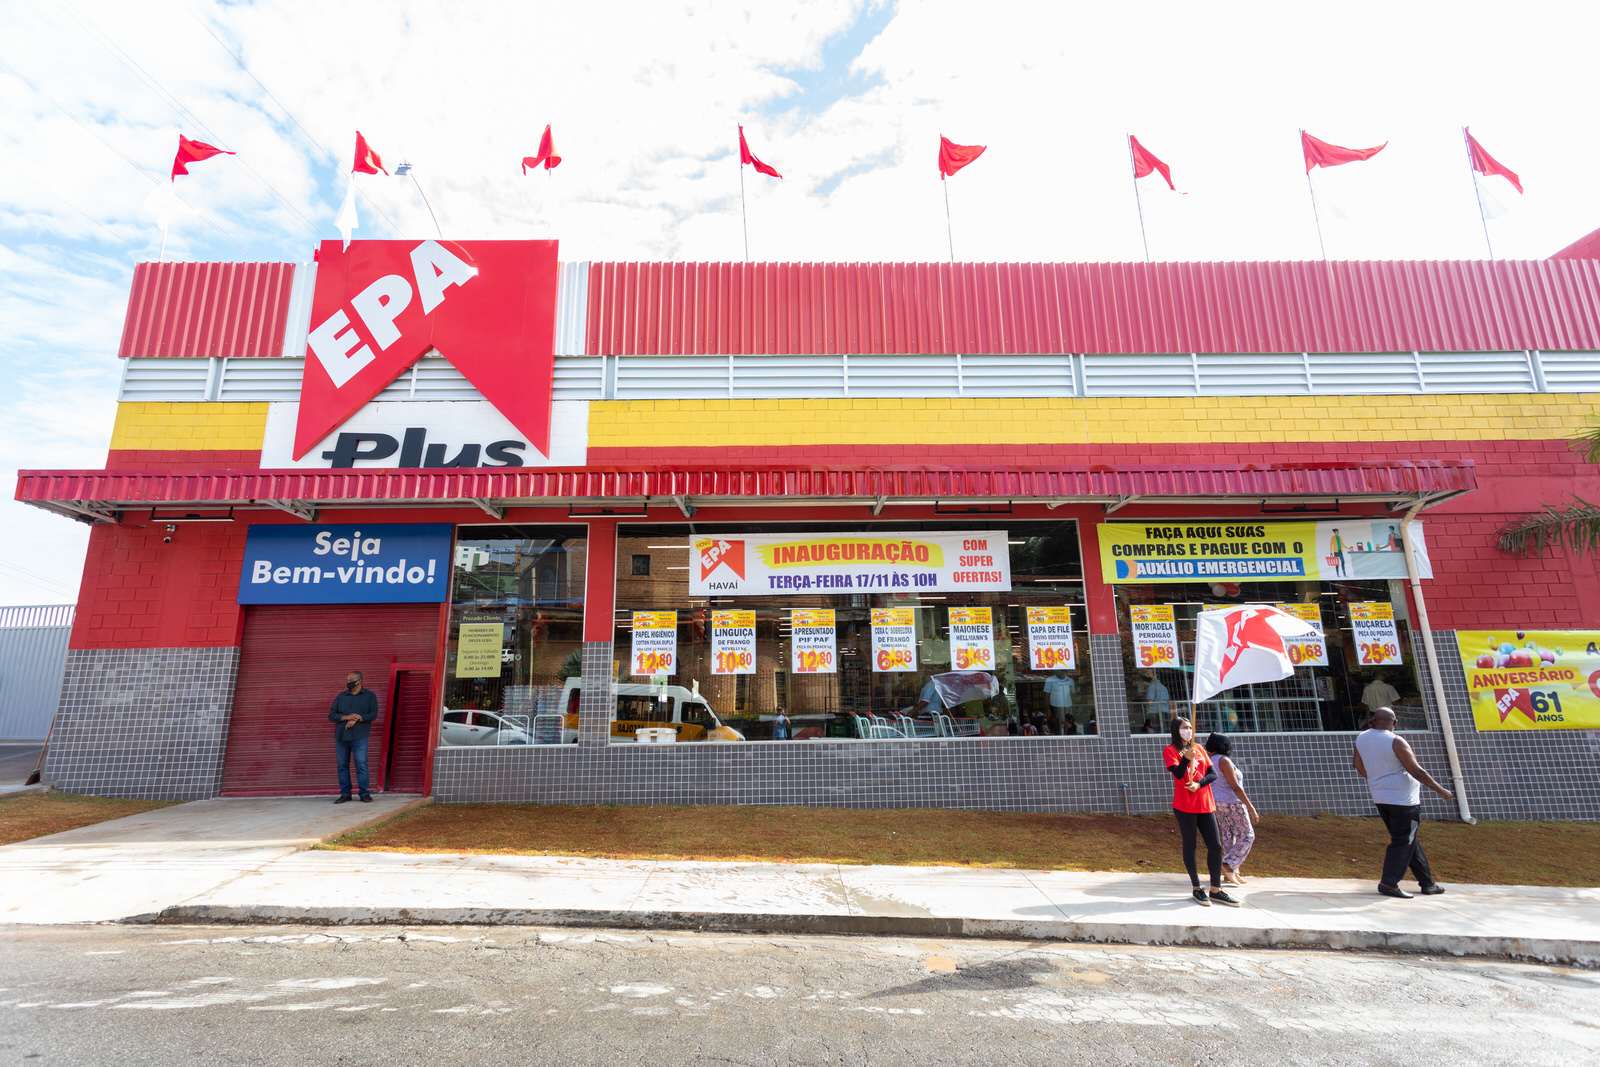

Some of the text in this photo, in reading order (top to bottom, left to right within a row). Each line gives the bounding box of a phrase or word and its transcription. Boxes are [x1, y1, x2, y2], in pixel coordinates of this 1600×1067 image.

[307, 239, 478, 389] EPA
[322, 427, 526, 468] Plus
[1145, 526, 1265, 541] FAÇA AQUI SUAS
[313, 531, 381, 561] Seja
[701, 540, 732, 570] EPA
[774, 541, 929, 564] INAUGURAÇÃO
[963, 540, 987, 551] COM
[1112, 541, 1303, 556] COMPRAS E PAGUE COM O
[959, 555, 993, 567] SUPER
[1136, 560, 1300, 576] AUXÍLIO EMERGENCIAL
[251, 559, 436, 585] Bem-vindo!
[768, 572, 937, 591] TERÇA-FEIRA 17/11 ÀS 10H
[953, 571, 1002, 583] OFERTAS!
[709, 580, 738, 590] HAVAÍ
[635, 630, 649, 638] PAPEL
[714, 628, 753, 639] LINGUIÇA
[794, 627, 834, 635] APRESUNTADO
[953, 625, 990, 633] MAIONESE
[1031, 626, 1046, 634] CAPA
[1057, 624, 1070, 633] FILÉ
[1135, 623, 1173, 631] MORTADELA
[1355, 620, 1393, 630] MUÇARELA
[635, 652, 673, 674] 12,80
[716, 652, 752, 673] 10,80
[797, 651, 832, 672] 12,80
[877, 650, 913, 671] 6,98
[955, 648, 991, 669] 5,48
[1034, 648, 1071, 669] 19,80
[1140, 646, 1175, 667] 5,98
[1360, 643, 1397, 664] 25,80
[1473, 667, 1574, 688] ANIVERSÁRIO
[1496, 688, 1562, 713] EPA 61
[1537, 714, 1564, 722] ANOS
